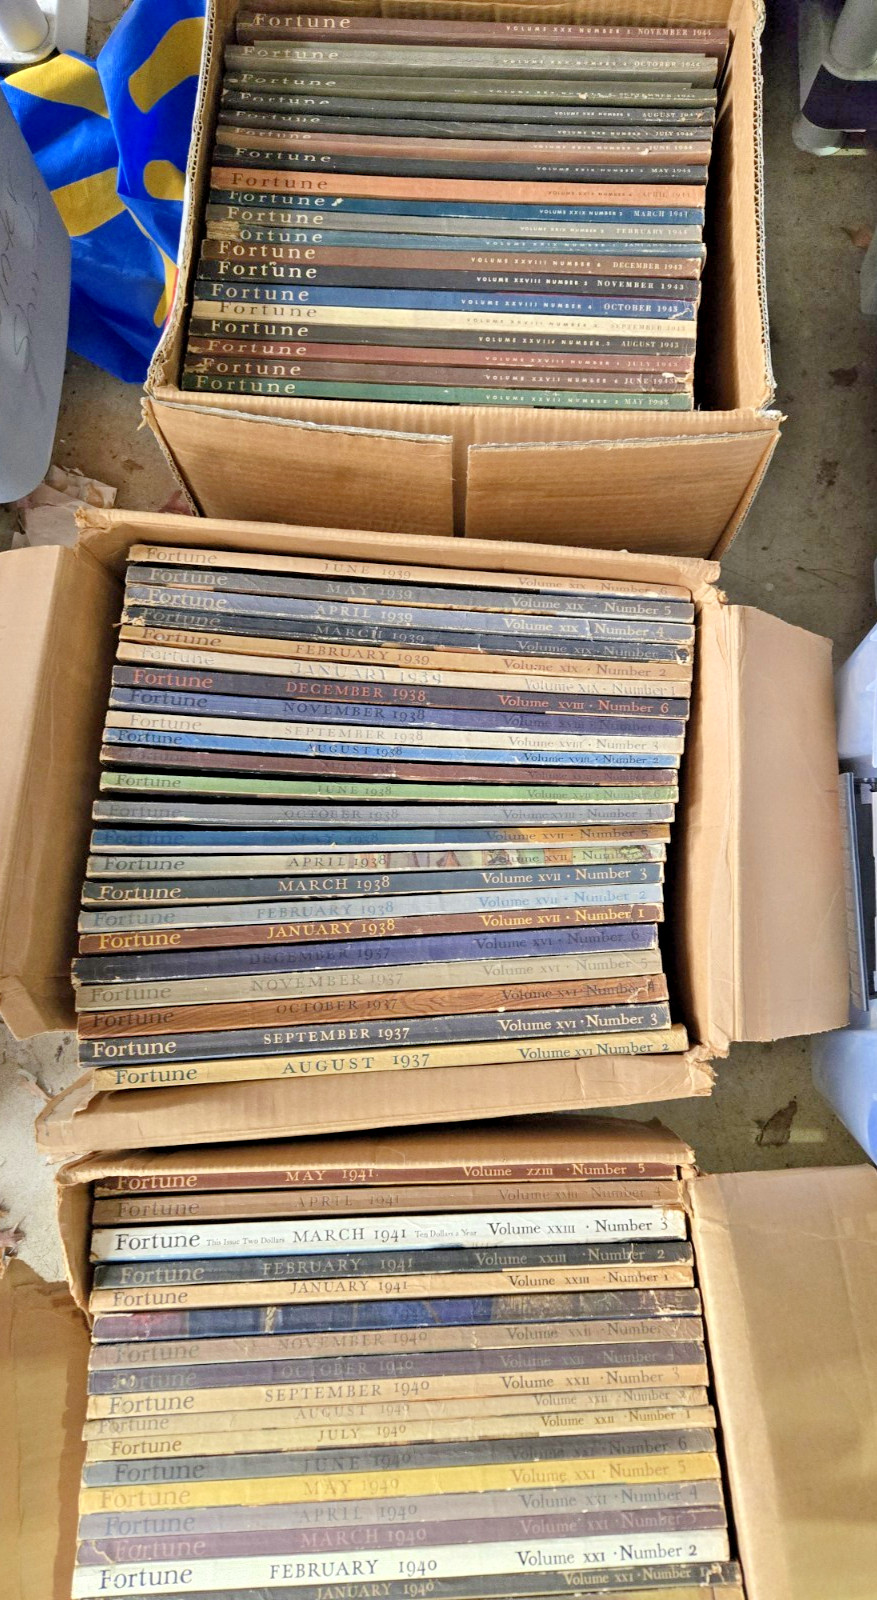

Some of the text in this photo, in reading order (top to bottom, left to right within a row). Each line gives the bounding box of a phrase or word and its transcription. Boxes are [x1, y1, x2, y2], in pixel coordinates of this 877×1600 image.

[254, 14, 350, 28] Fortune
[638, 28, 688, 36] NOVEMBER
[242, 46, 338, 59] Fortune
[236, 148, 331, 163] Fortune
[232, 172, 328, 190] Fortune
[228, 208, 324, 224] Fortune
[220, 241, 315, 260] Fortune
[613, 261, 660, 270] DECEMBER
[219, 261, 317, 279] Fortune
[597, 280, 654, 289] NOVEMBER
[212, 284, 309, 301] Fortune
[604, 303, 651, 312] OCTOBER
[220, 302, 317, 318] Fortune
[212, 320, 308, 337] Fortune
[208, 341, 307, 355] Fortune
[203, 358, 301, 376] Fortune
[196, 376, 296, 393] Fortune
[150, 568, 659, 615] Fortune MAY Volume Number
[149, 589, 649, 636] Fortune Volume Number
[142, 628, 651, 677] Fortune FEBRUARY Number
[130, 690, 384, 718] Fortune NOVEMBER
[132, 669, 213, 688] Fortune
[286, 681, 383, 698] DECEMBER
[392, 688, 426, 701] 1938
[498, 695, 549, 708] Volume
[598, 700, 654, 712] Number
[661, 703, 669, 713] 6
[130, 714, 385, 740] Fortune SEPTEMBER
[118, 730, 647, 764] Fortune Number
[115, 774, 181, 788] Fortune
[104, 857, 185, 871] Fortune
[99, 886, 181, 900] Fortune
[278, 878, 348, 891] MARCH
[356, 876, 390, 890] 1938
[480, 871, 533, 884] Volume
[575, 868, 631, 880] Number
[640, 867, 648, 880] 3
[257, 904, 352, 919] FEBRUARY
[99, 933, 181, 949] Fortune
[267, 922, 352, 939] JANUARY
[361, 919, 396, 935] 1938
[480, 914, 532, 927] Volume
[575, 909, 631, 922] Number
[91, 974, 362, 1002] Fortune NOVEMBER
[93, 1010, 174, 1027] Fortune
[92, 1039, 177, 1057] Fortune
[264, 1028, 370, 1044] SEPTEMBER
[378, 1027, 410, 1041] 1937
[498, 1018, 551, 1032] Volume
[586, 1014, 644, 1027] Number
[650, 1013, 658, 1025] 3
[115, 1067, 198, 1084] Fortune
[282, 1057, 375, 1074] AUGUST
[393, 1053, 429, 1069] 1937
[518, 1048, 570, 1060] Volume
[596, 1042, 653, 1055] Number
[662, 1043, 669, 1051] 2
[117, 1163, 645, 1190] Fortune MAY Volume Number 5
[117, 1201, 199, 1217] Fortune
[115, 1233, 200, 1251] Fortune
[293, 1228, 365, 1243] MARCH
[374, 1229, 406, 1243] 1941
[415, 1230, 427, 1238] Ten
[486, 1222, 540, 1236] Volume
[595, 1220, 652, 1232] Number
[660, 1217, 668, 1230] 3
[120, 1248, 644, 1284] Fortune FEBRUARY Volume Number
[113, 1272, 657, 1306] Fortune JANUARY Volume Number
[109, 1370, 663, 1414] Fortune SEPTEMBER 1940 Volume Number
[111, 1411, 676, 1456] Fortune JULY Volume Number
[115, 1462, 204, 1482] Fortune
[101, 1488, 191, 1508] Fortune
[105, 1515, 195, 1536] Fortune
[99, 1568, 192, 1589] Fortune
[270, 1560, 379, 1579] FEBRUARY
[398, 1560, 438, 1574] 1940
[517, 1551, 575, 1566] Volume
[619, 1545, 682, 1561] Number
[689, 1544, 697, 1556] 2
[563, 1568, 691, 1585] Volume Number
